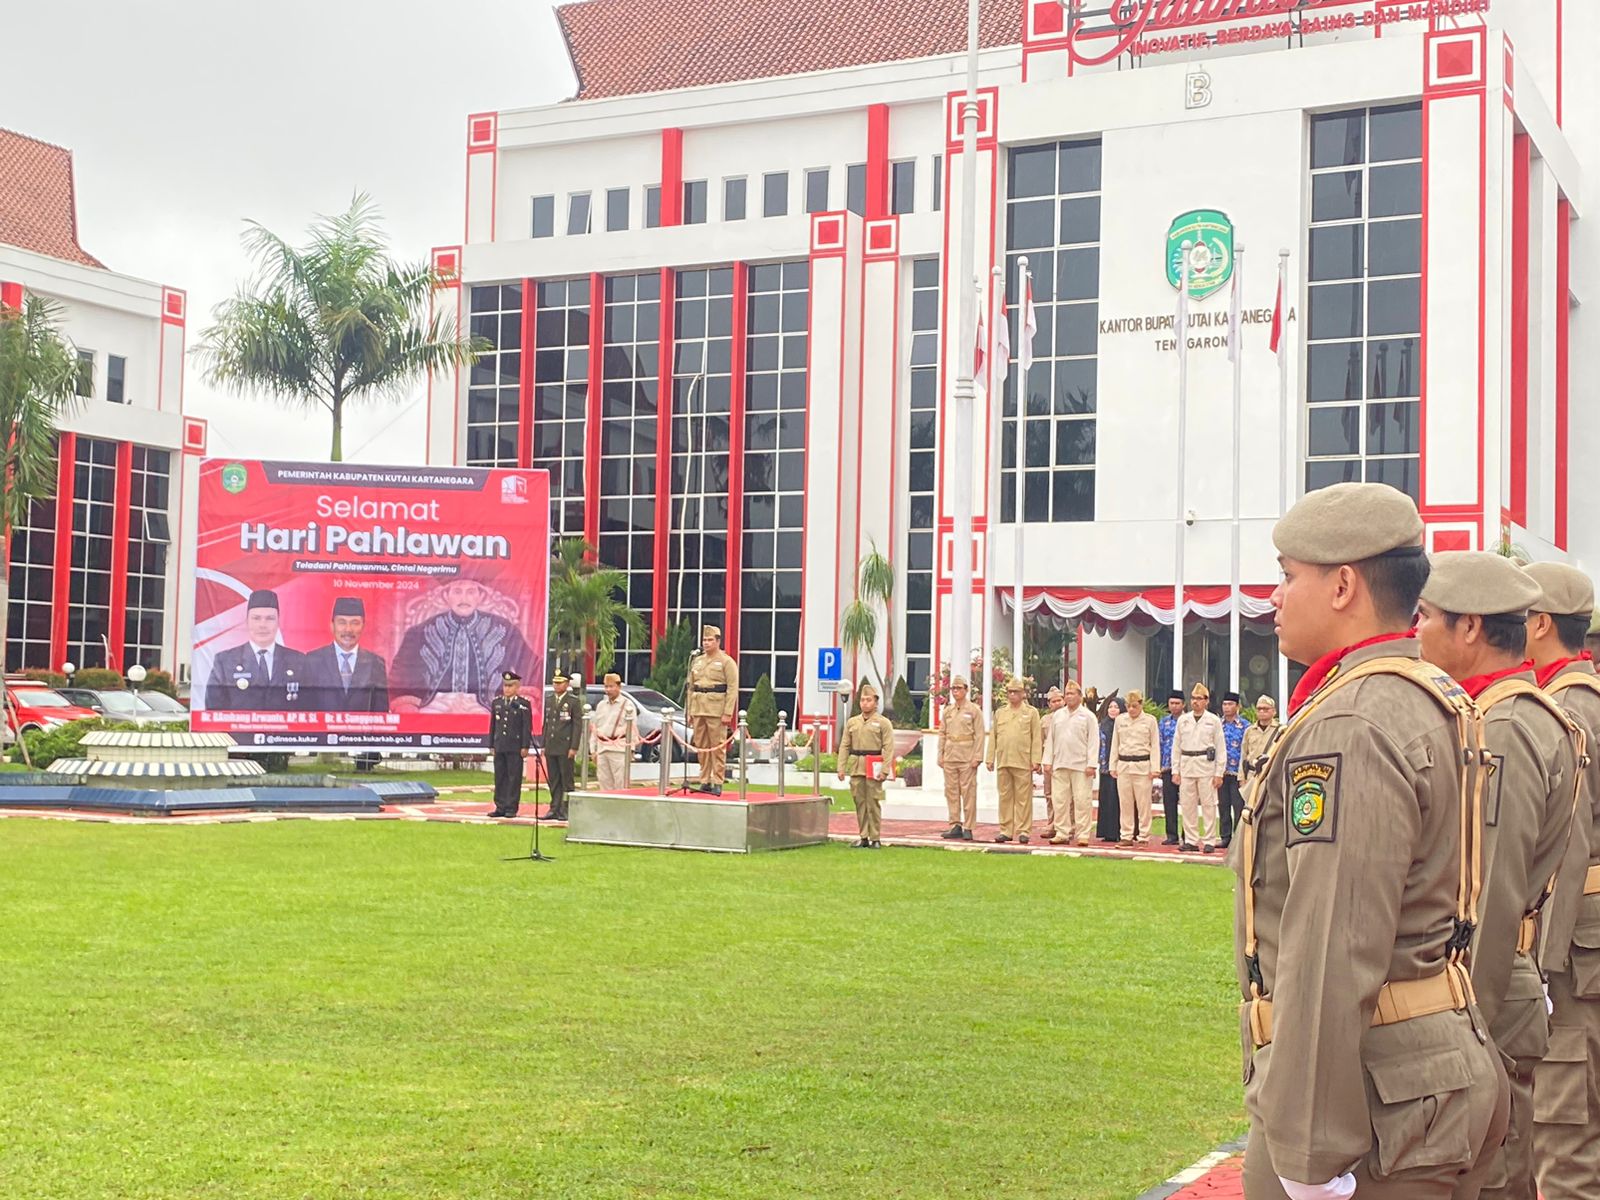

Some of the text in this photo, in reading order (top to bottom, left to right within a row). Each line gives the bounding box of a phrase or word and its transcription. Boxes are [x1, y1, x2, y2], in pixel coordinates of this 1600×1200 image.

[1216, 20, 1294, 46] BERDAYA
[1300, 12, 1357, 35] SAING
[1362, 6, 1401, 27] DAN
[1407, 0, 1491, 21] MANDIRI
[1185, 72, 1213, 110] B
[1100, 317, 1143, 334] KANTOR
[1145, 314, 1176, 330] BUPAT
[1187, 312, 1212, 329] UTAI
[1155, 335, 1229, 352] TENGARON
[278, 469, 475, 486] PEMERINTAH KABUPATEN KUTAI KARTANEGARA
[316, 495, 440, 521] Selamat
[240, 521, 511, 559] Hari Pahlawan
[296, 560, 457, 575] Teladani Pahlawanmu, Cintai Negerimu
[333, 578, 419, 591] 10 November 2024
[824, 651, 836, 675] P
[266, 734, 319, 744] @dinsos.kukar
[432, 735, 482, 745] @dinsos.kukar
